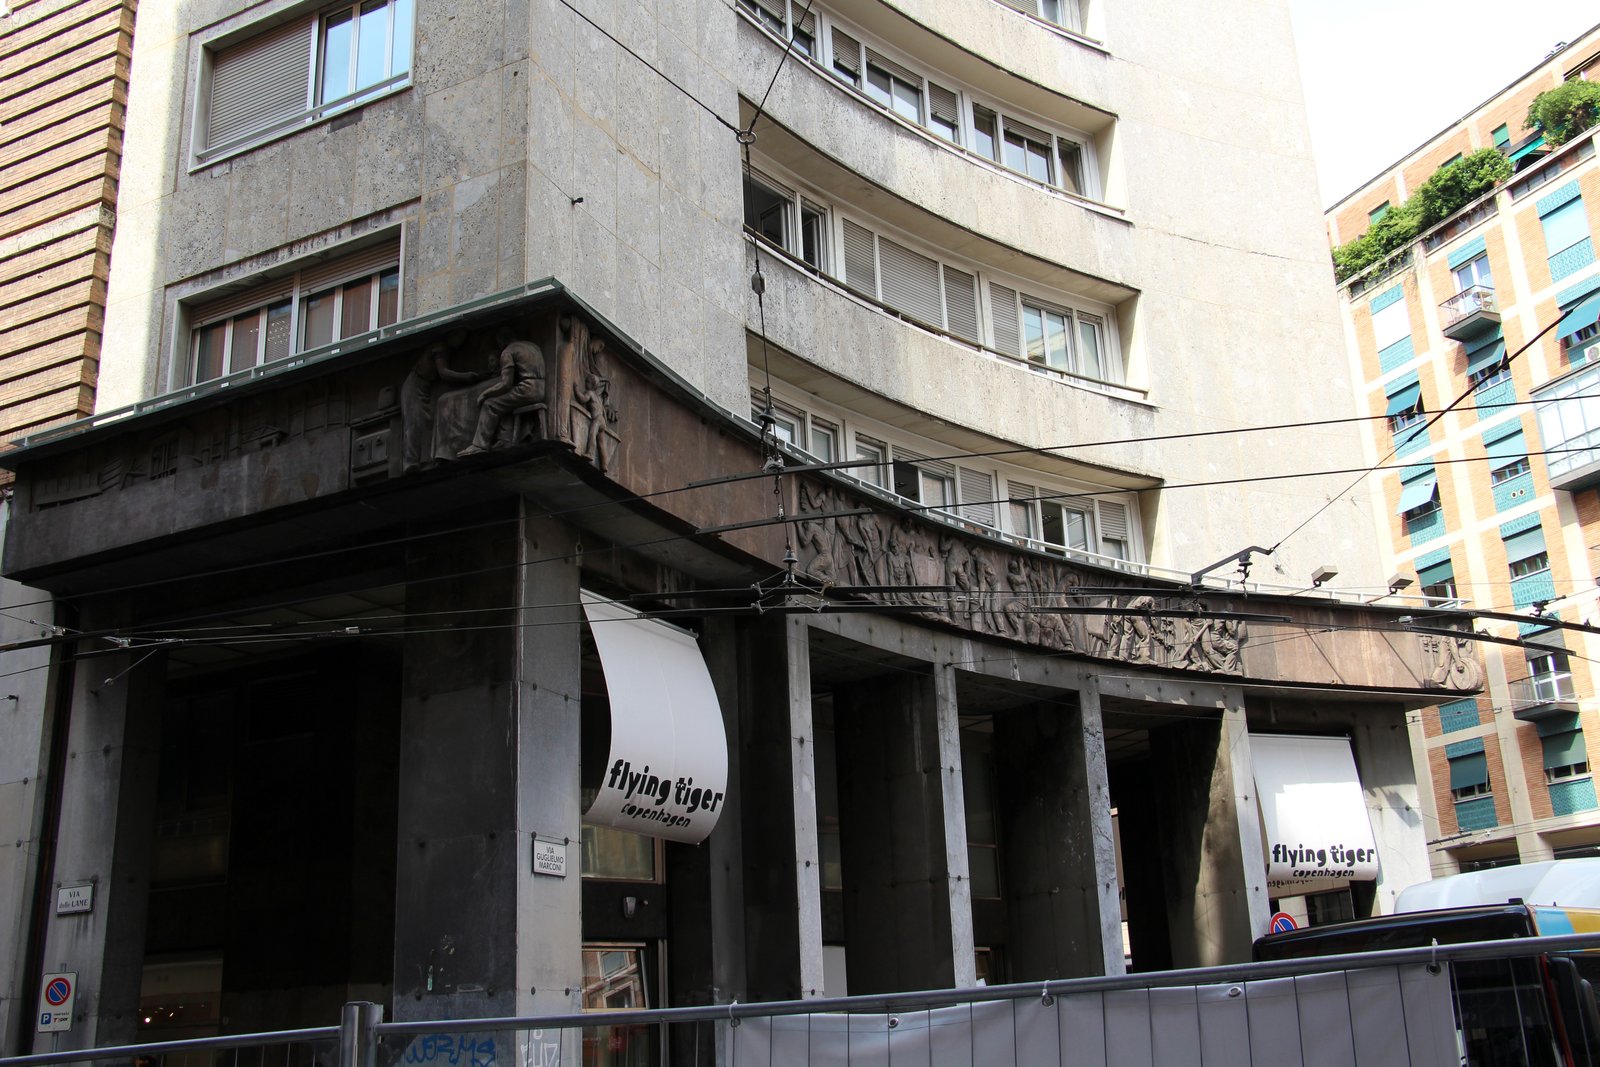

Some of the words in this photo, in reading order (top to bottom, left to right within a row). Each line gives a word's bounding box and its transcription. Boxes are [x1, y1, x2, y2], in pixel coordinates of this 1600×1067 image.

[608, 759, 671, 806] flying
[675, 777, 723, 813] tiger
[621, 803, 691, 828] copenhagen
[546, 846, 555, 854] VIA
[1273, 843, 1327, 868] flying
[1330, 843, 1375, 868] tiger
[536, 852, 564, 864] GUGLIELMO
[538, 861, 562, 871] MARCONI
[1292, 868, 1355, 879] copenhagen
[69, 890, 80, 898] VIA
[71, 899, 89, 908] LAME
